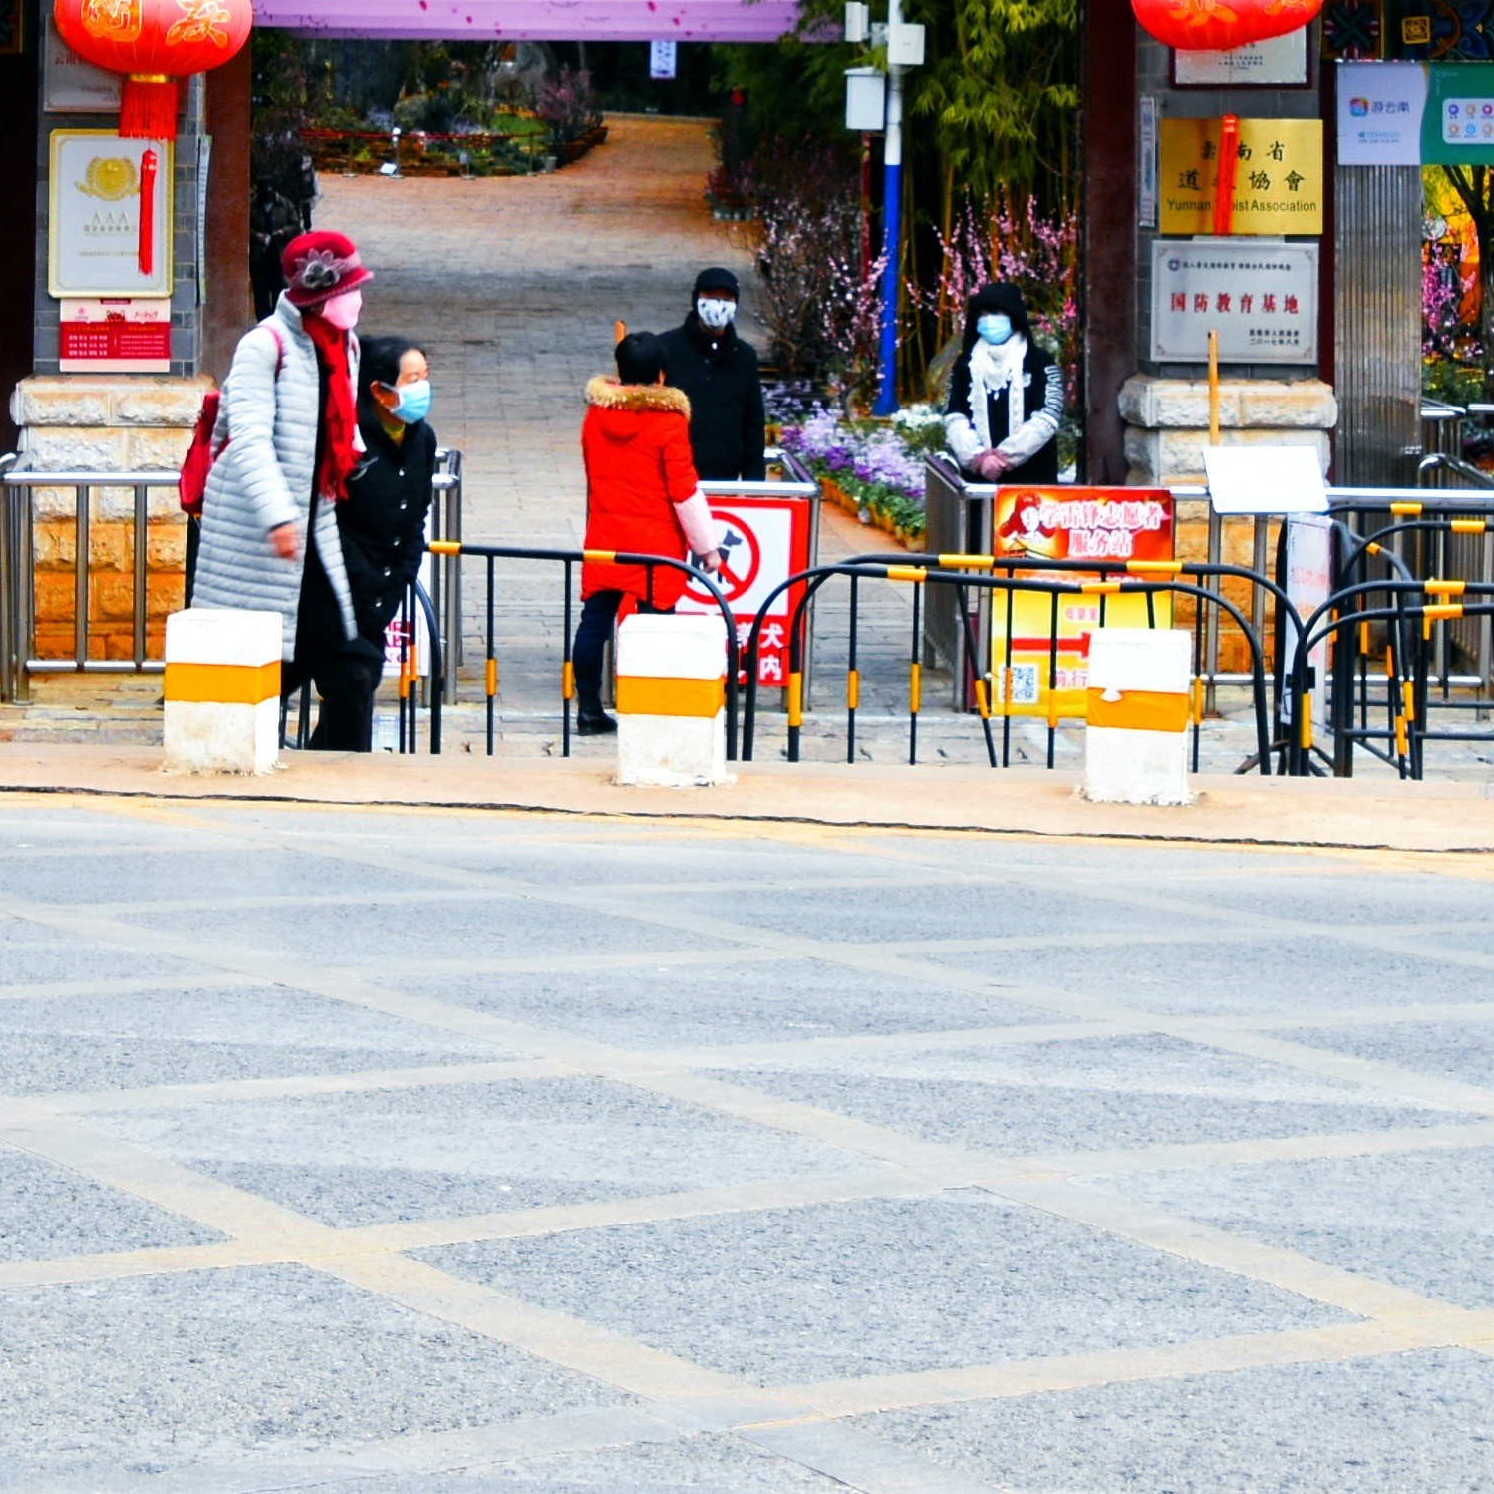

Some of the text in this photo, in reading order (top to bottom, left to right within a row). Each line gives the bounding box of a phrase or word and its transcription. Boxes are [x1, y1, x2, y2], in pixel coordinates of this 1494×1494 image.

[1178, 169, 1305, 192] 道協會
[1167, 198, 1212, 212] Yunnan
[1250, 198, 1317, 212] Association
[1171, 292, 1299, 314] 国防教育基地
[1039, 500, 1164, 530] 学雷锋志愿者
[1067, 529, 1133, 557] 服务站
